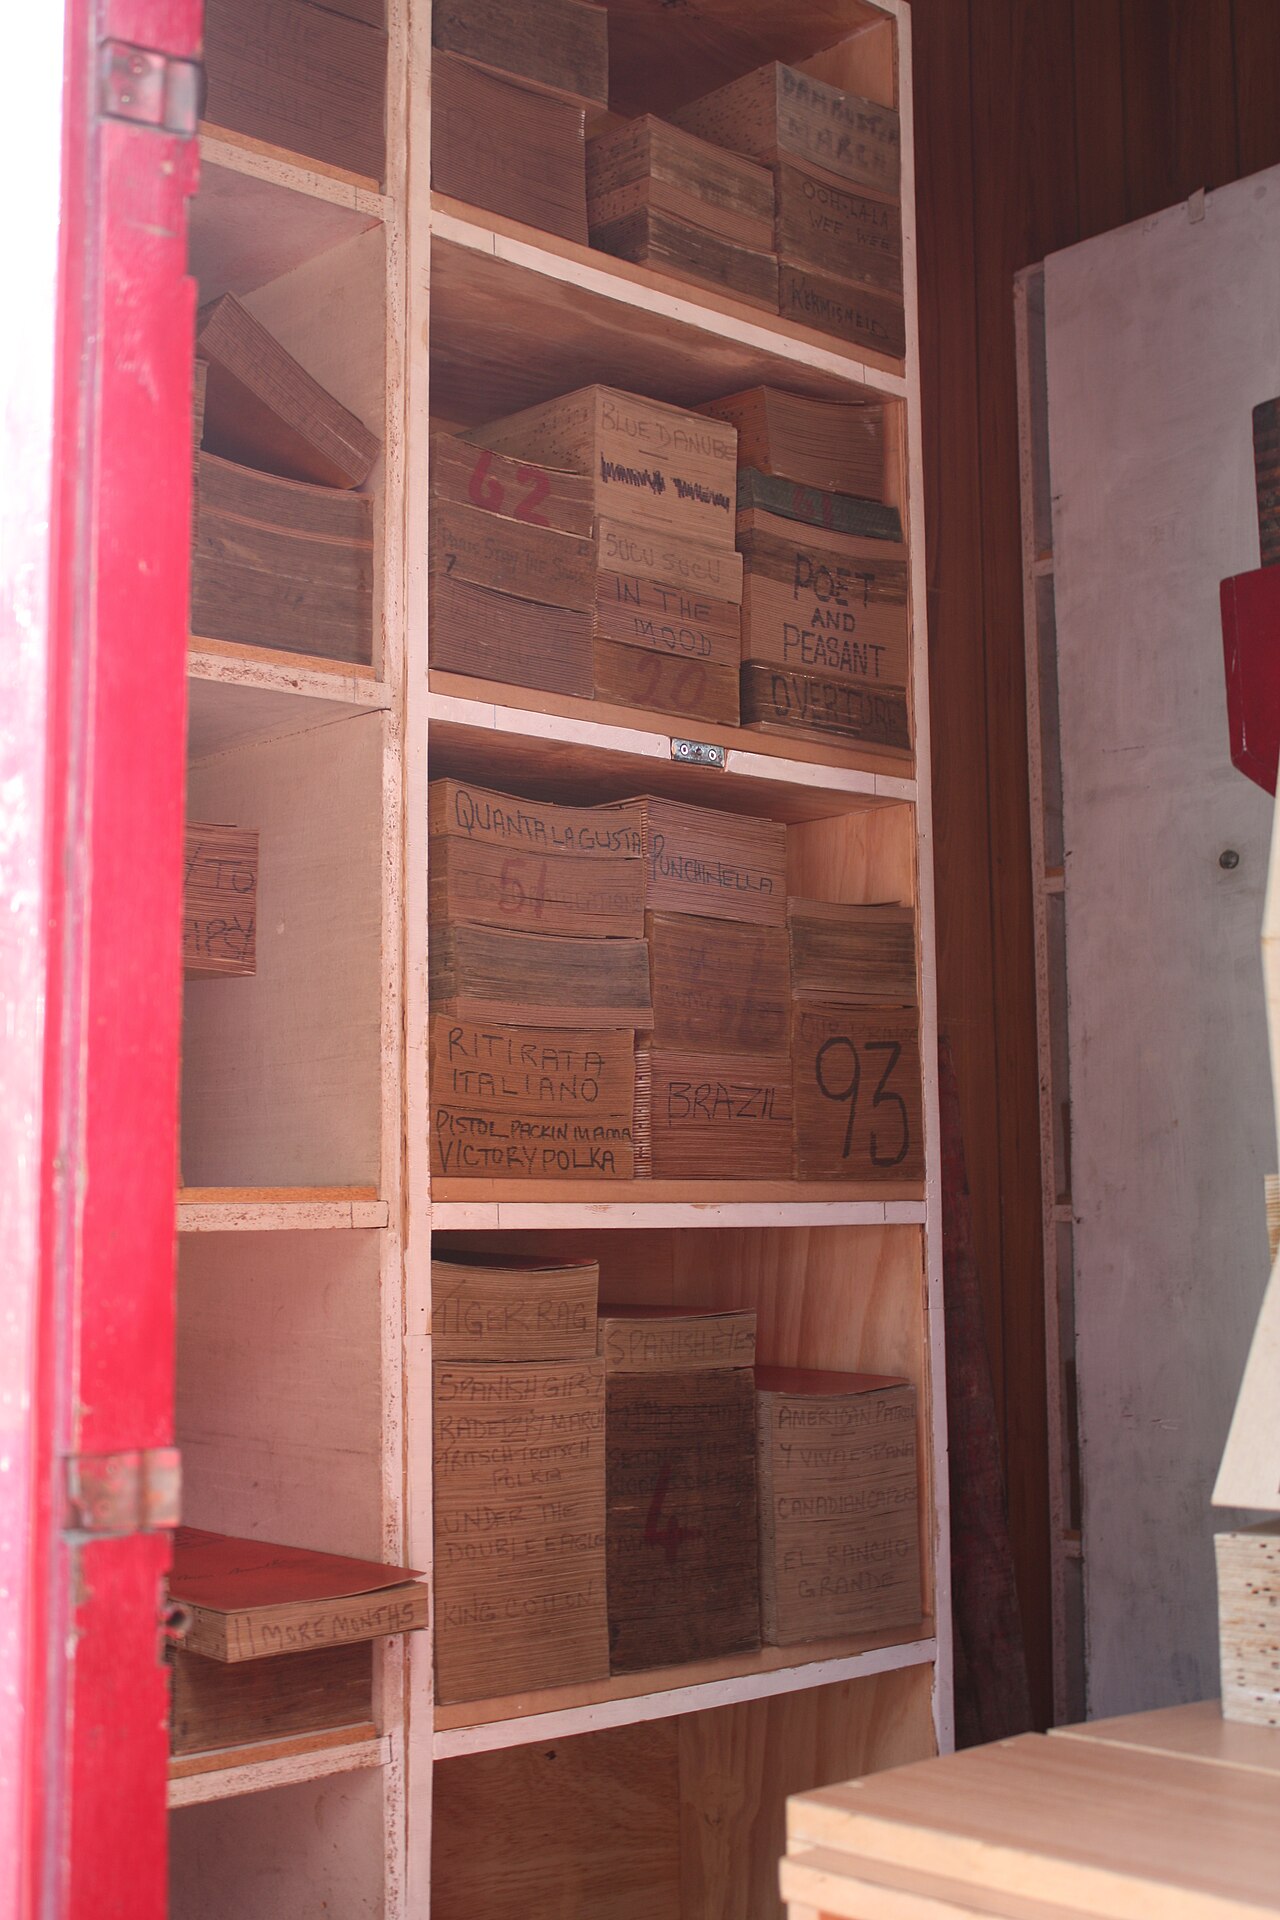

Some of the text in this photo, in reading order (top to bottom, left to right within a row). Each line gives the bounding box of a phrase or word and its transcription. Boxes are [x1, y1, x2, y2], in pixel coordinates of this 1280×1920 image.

[601, 401, 738, 461] BLUE DANUBE
[616, 577, 713, 623] IN THE
[794, 551, 877, 608] POET
[634, 618, 713, 657] MOOD
[811, 607, 857, 633] AND
[783, 622, 886, 678] PEASANT
[652, 834, 774, 895] PUNCHINELLA
[449, 1027, 605, 1076] RITIRATA
[453, 1068, 599, 1102] ITALIANO
[668, 1082, 793, 1129] BRAZIL
[816, 1037, 910, 1167] 93
[511, 1120, 569, 1141] PACKIN
[438, 1140, 615, 1175] VICTORY POLKA
[438, 1374, 538, 1402] SPANISH
[331, 1601, 416, 1640] MONTHS
[443, 1593, 497, 1632] KING
